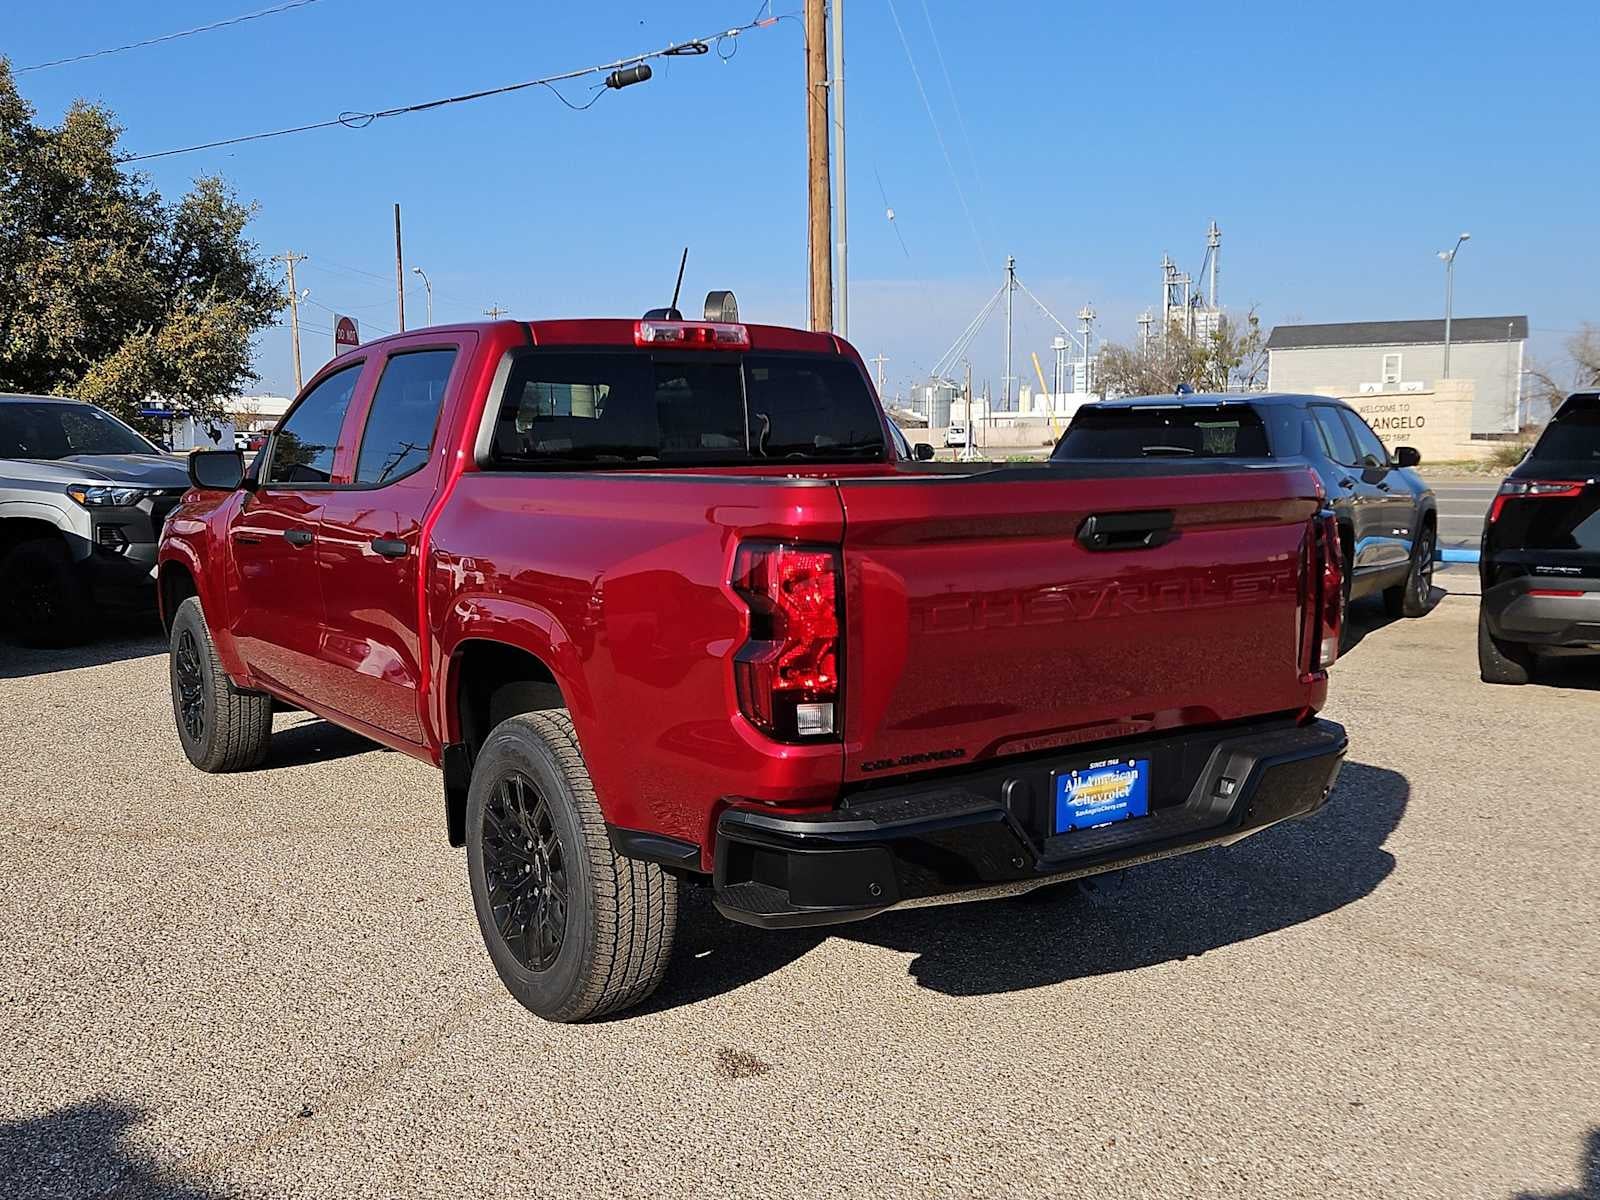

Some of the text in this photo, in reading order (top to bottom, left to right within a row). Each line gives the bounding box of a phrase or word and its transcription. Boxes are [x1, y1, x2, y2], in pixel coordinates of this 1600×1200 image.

[1359, 403, 1410, 414] WELCOME TO
[1373, 416, 1425, 430] ANGELO
[921, 569, 1297, 634] CHEVROLET
[1064, 769, 1139, 793] All American
[1073, 786, 1131, 807] Chevrolet
